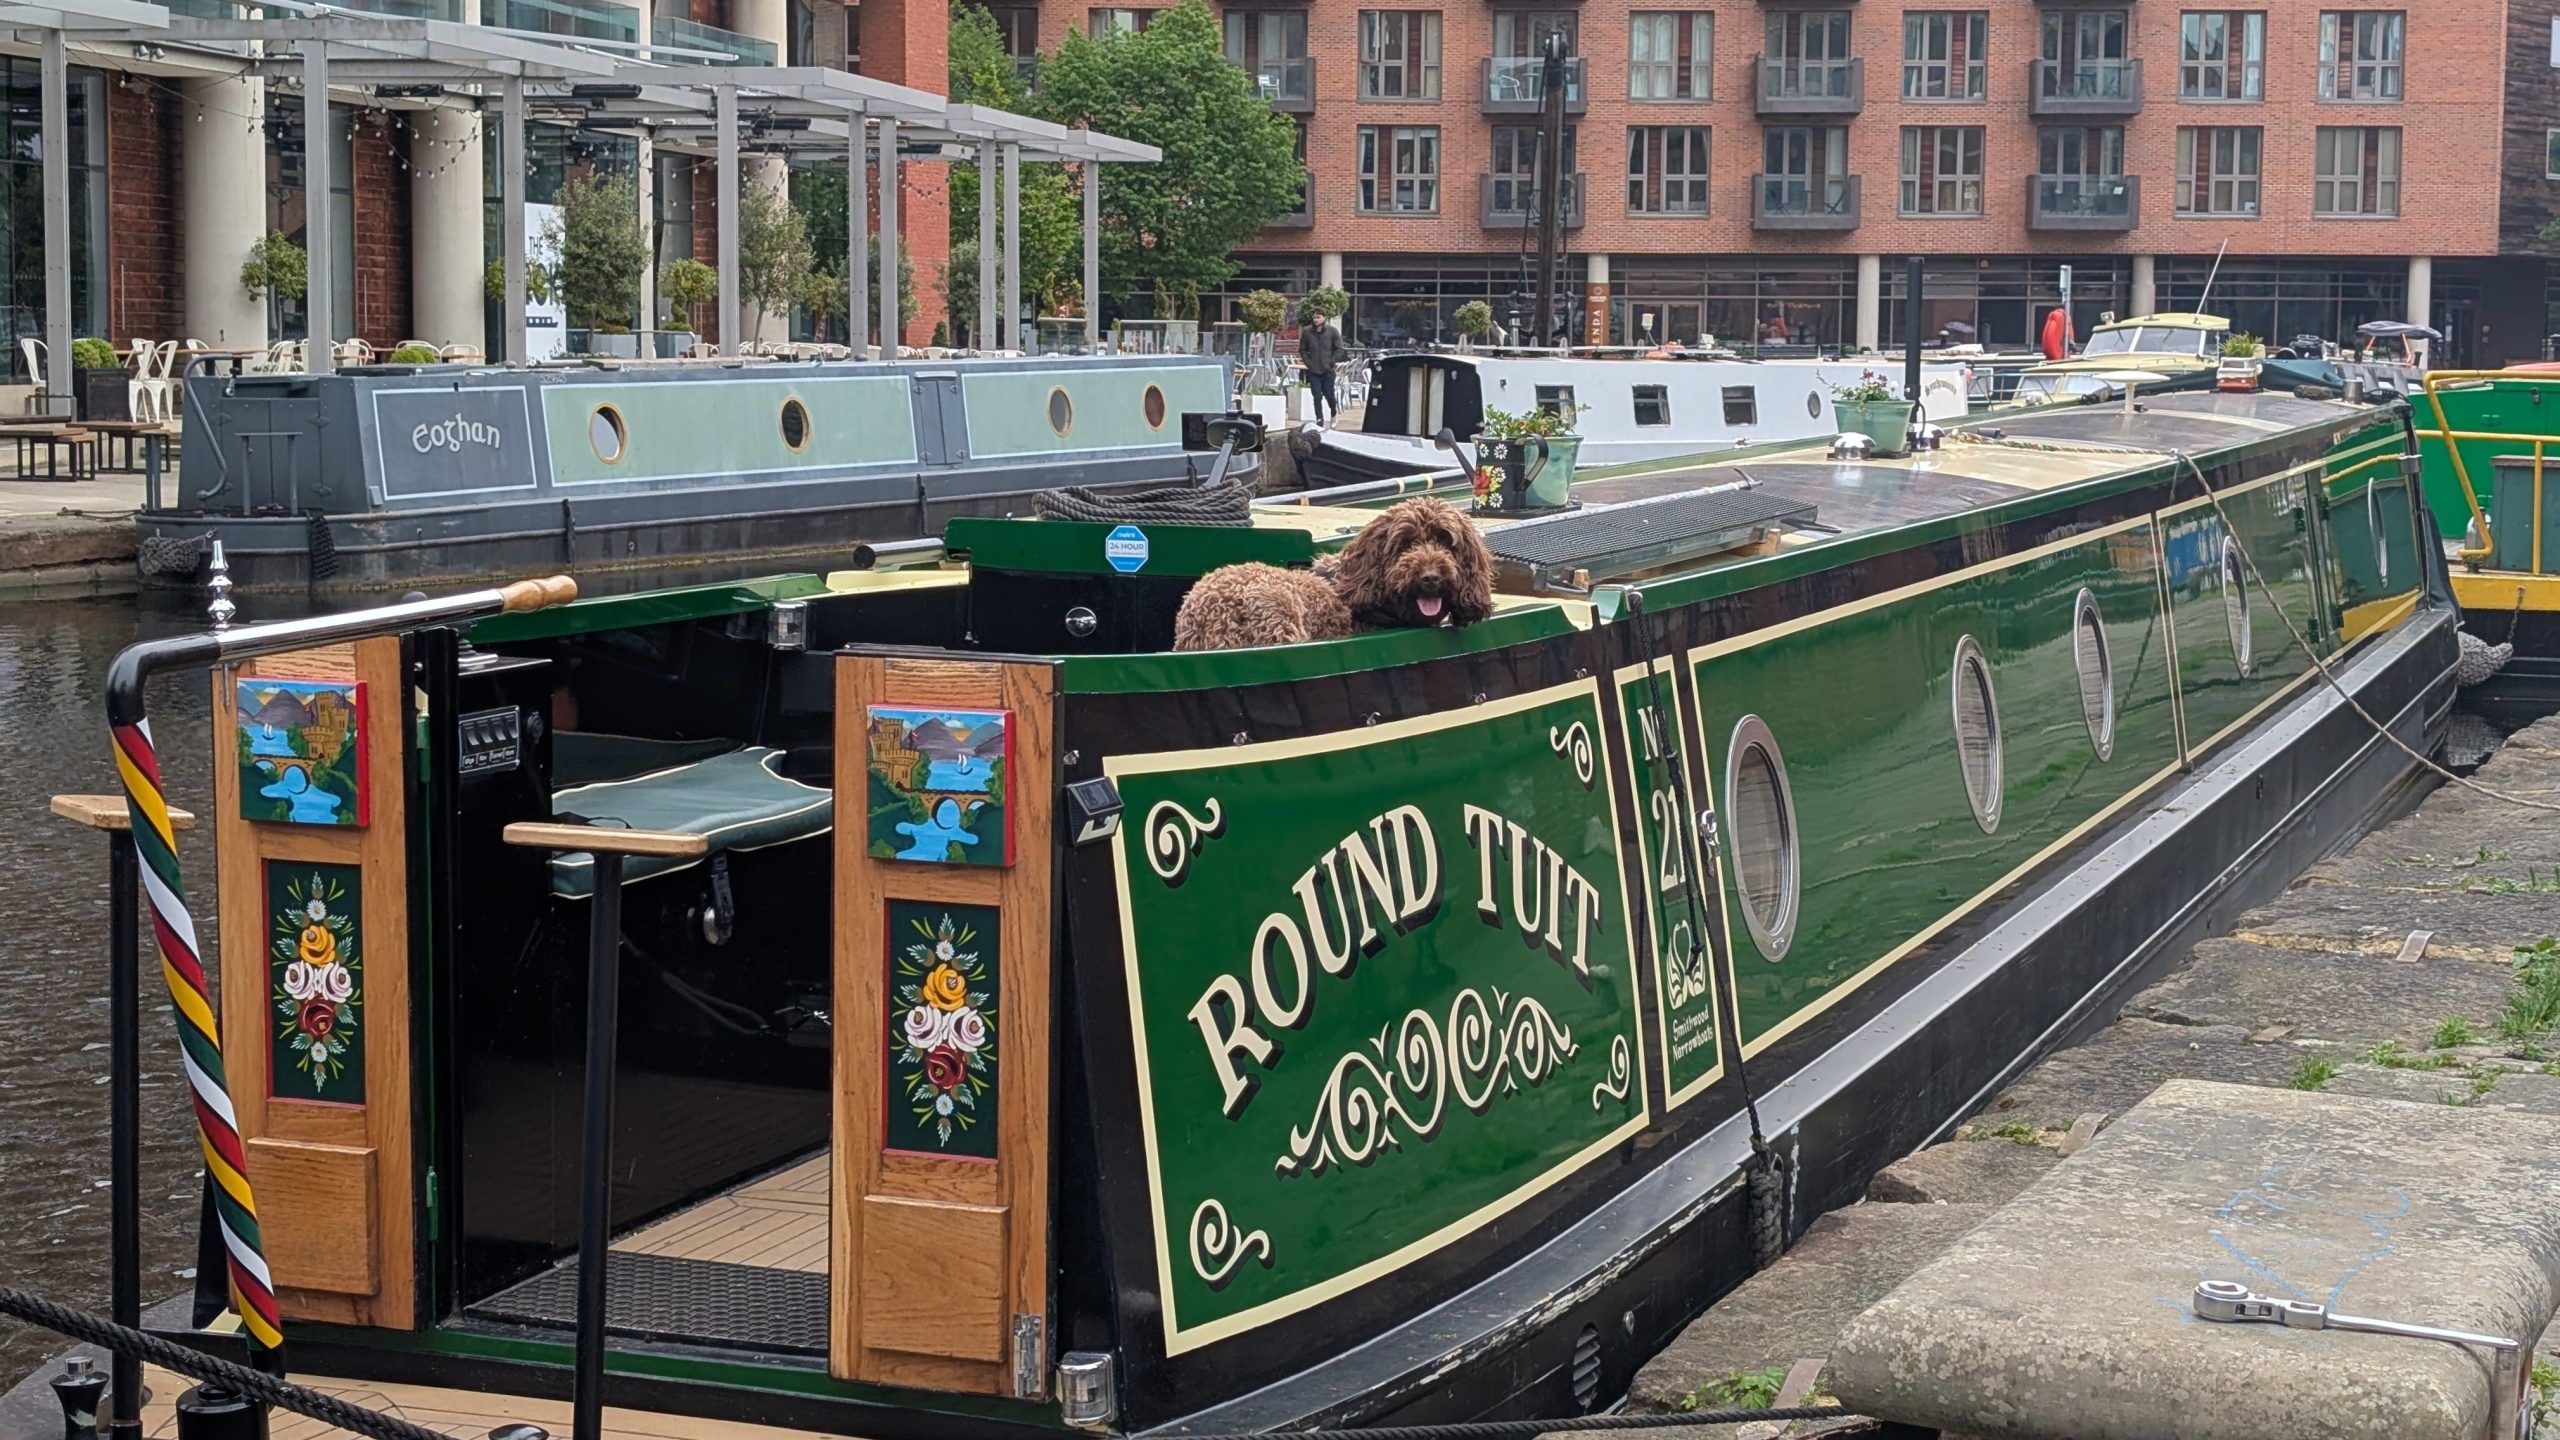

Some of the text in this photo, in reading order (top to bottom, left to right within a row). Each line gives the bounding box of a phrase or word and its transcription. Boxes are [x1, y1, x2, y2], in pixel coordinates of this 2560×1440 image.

[1110, 542, 1144, 550] 24 HOUR
[1637, 704, 1665, 761] N
[1652, 784, 1686, 892] 21
[1188, 803, 1599, 1118] ROUND TUIT
[1672, 1026, 1714, 1064] Narrowboats
[1673, 1003, 1709, 1042] Smithwood
